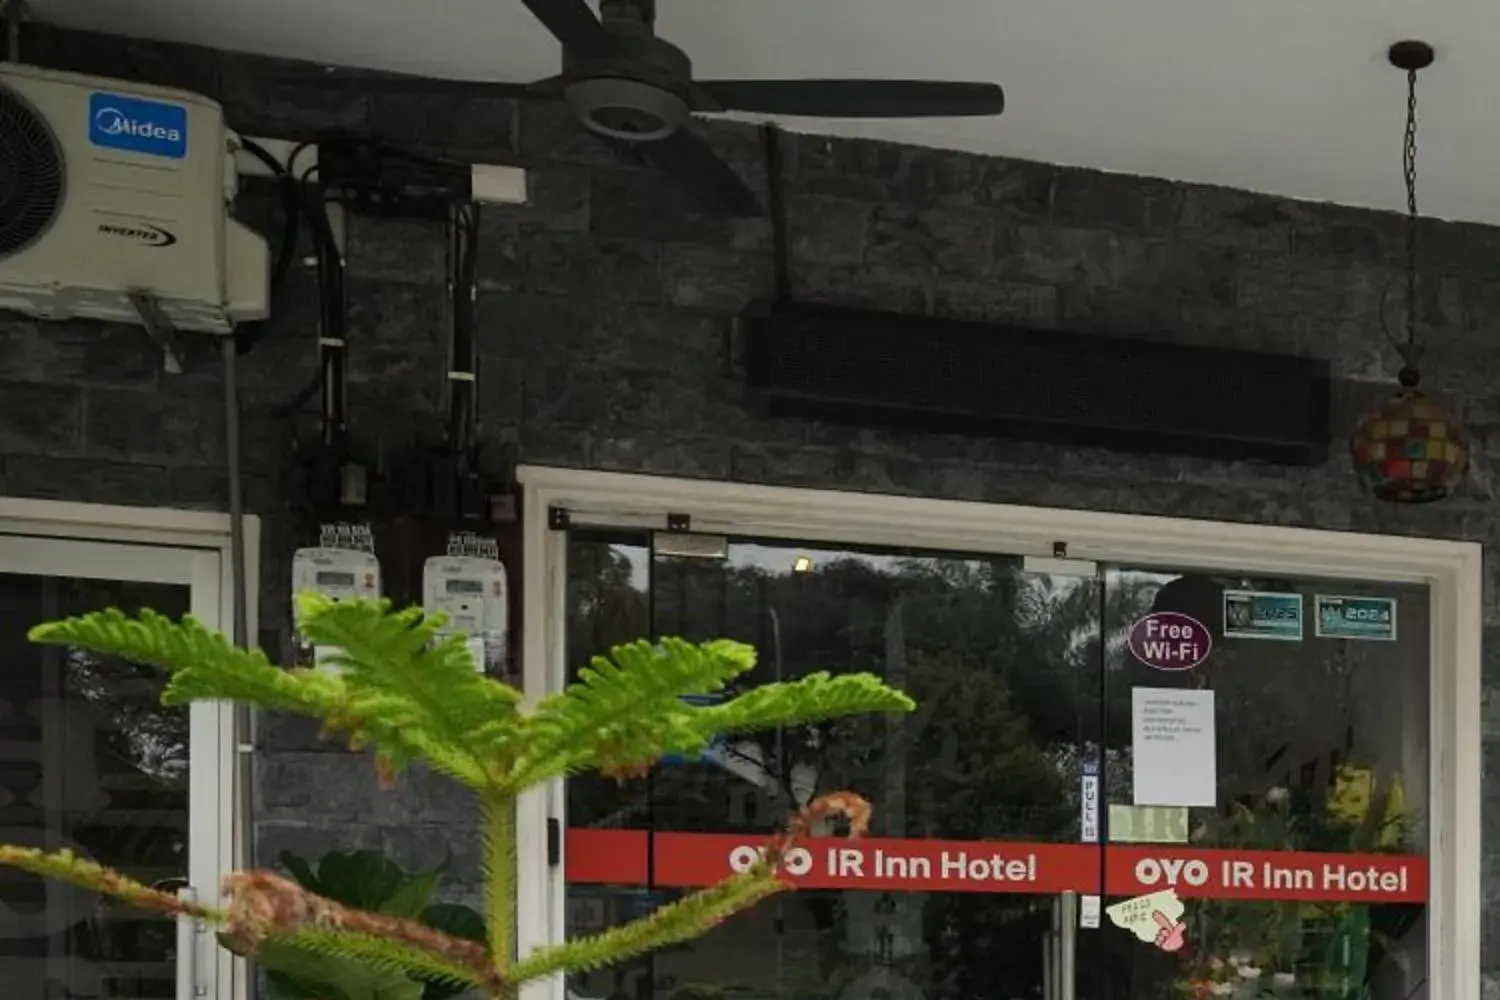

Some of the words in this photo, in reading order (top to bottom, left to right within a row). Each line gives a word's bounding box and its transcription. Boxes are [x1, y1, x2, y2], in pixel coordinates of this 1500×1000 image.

[107, 114, 180, 142] Midea
[98, 223, 159, 241] INVERTER
[1346, 607, 1389, 621] 2024
[1146, 620, 1193, 639] Free
[1144, 641, 1199, 660] Wi-Fi
[729, 846, 812, 875] OO
[827, 848, 865, 877] IR
[875, 850, 931, 878] Inn
[940, 851, 1037, 881] Hotel
[1135, 858, 1209, 885] OYO
[1222, 861, 1255, 888] IR
[1263, 862, 1314, 889] Inn
[1322, 864, 1407, 892] Hotel
